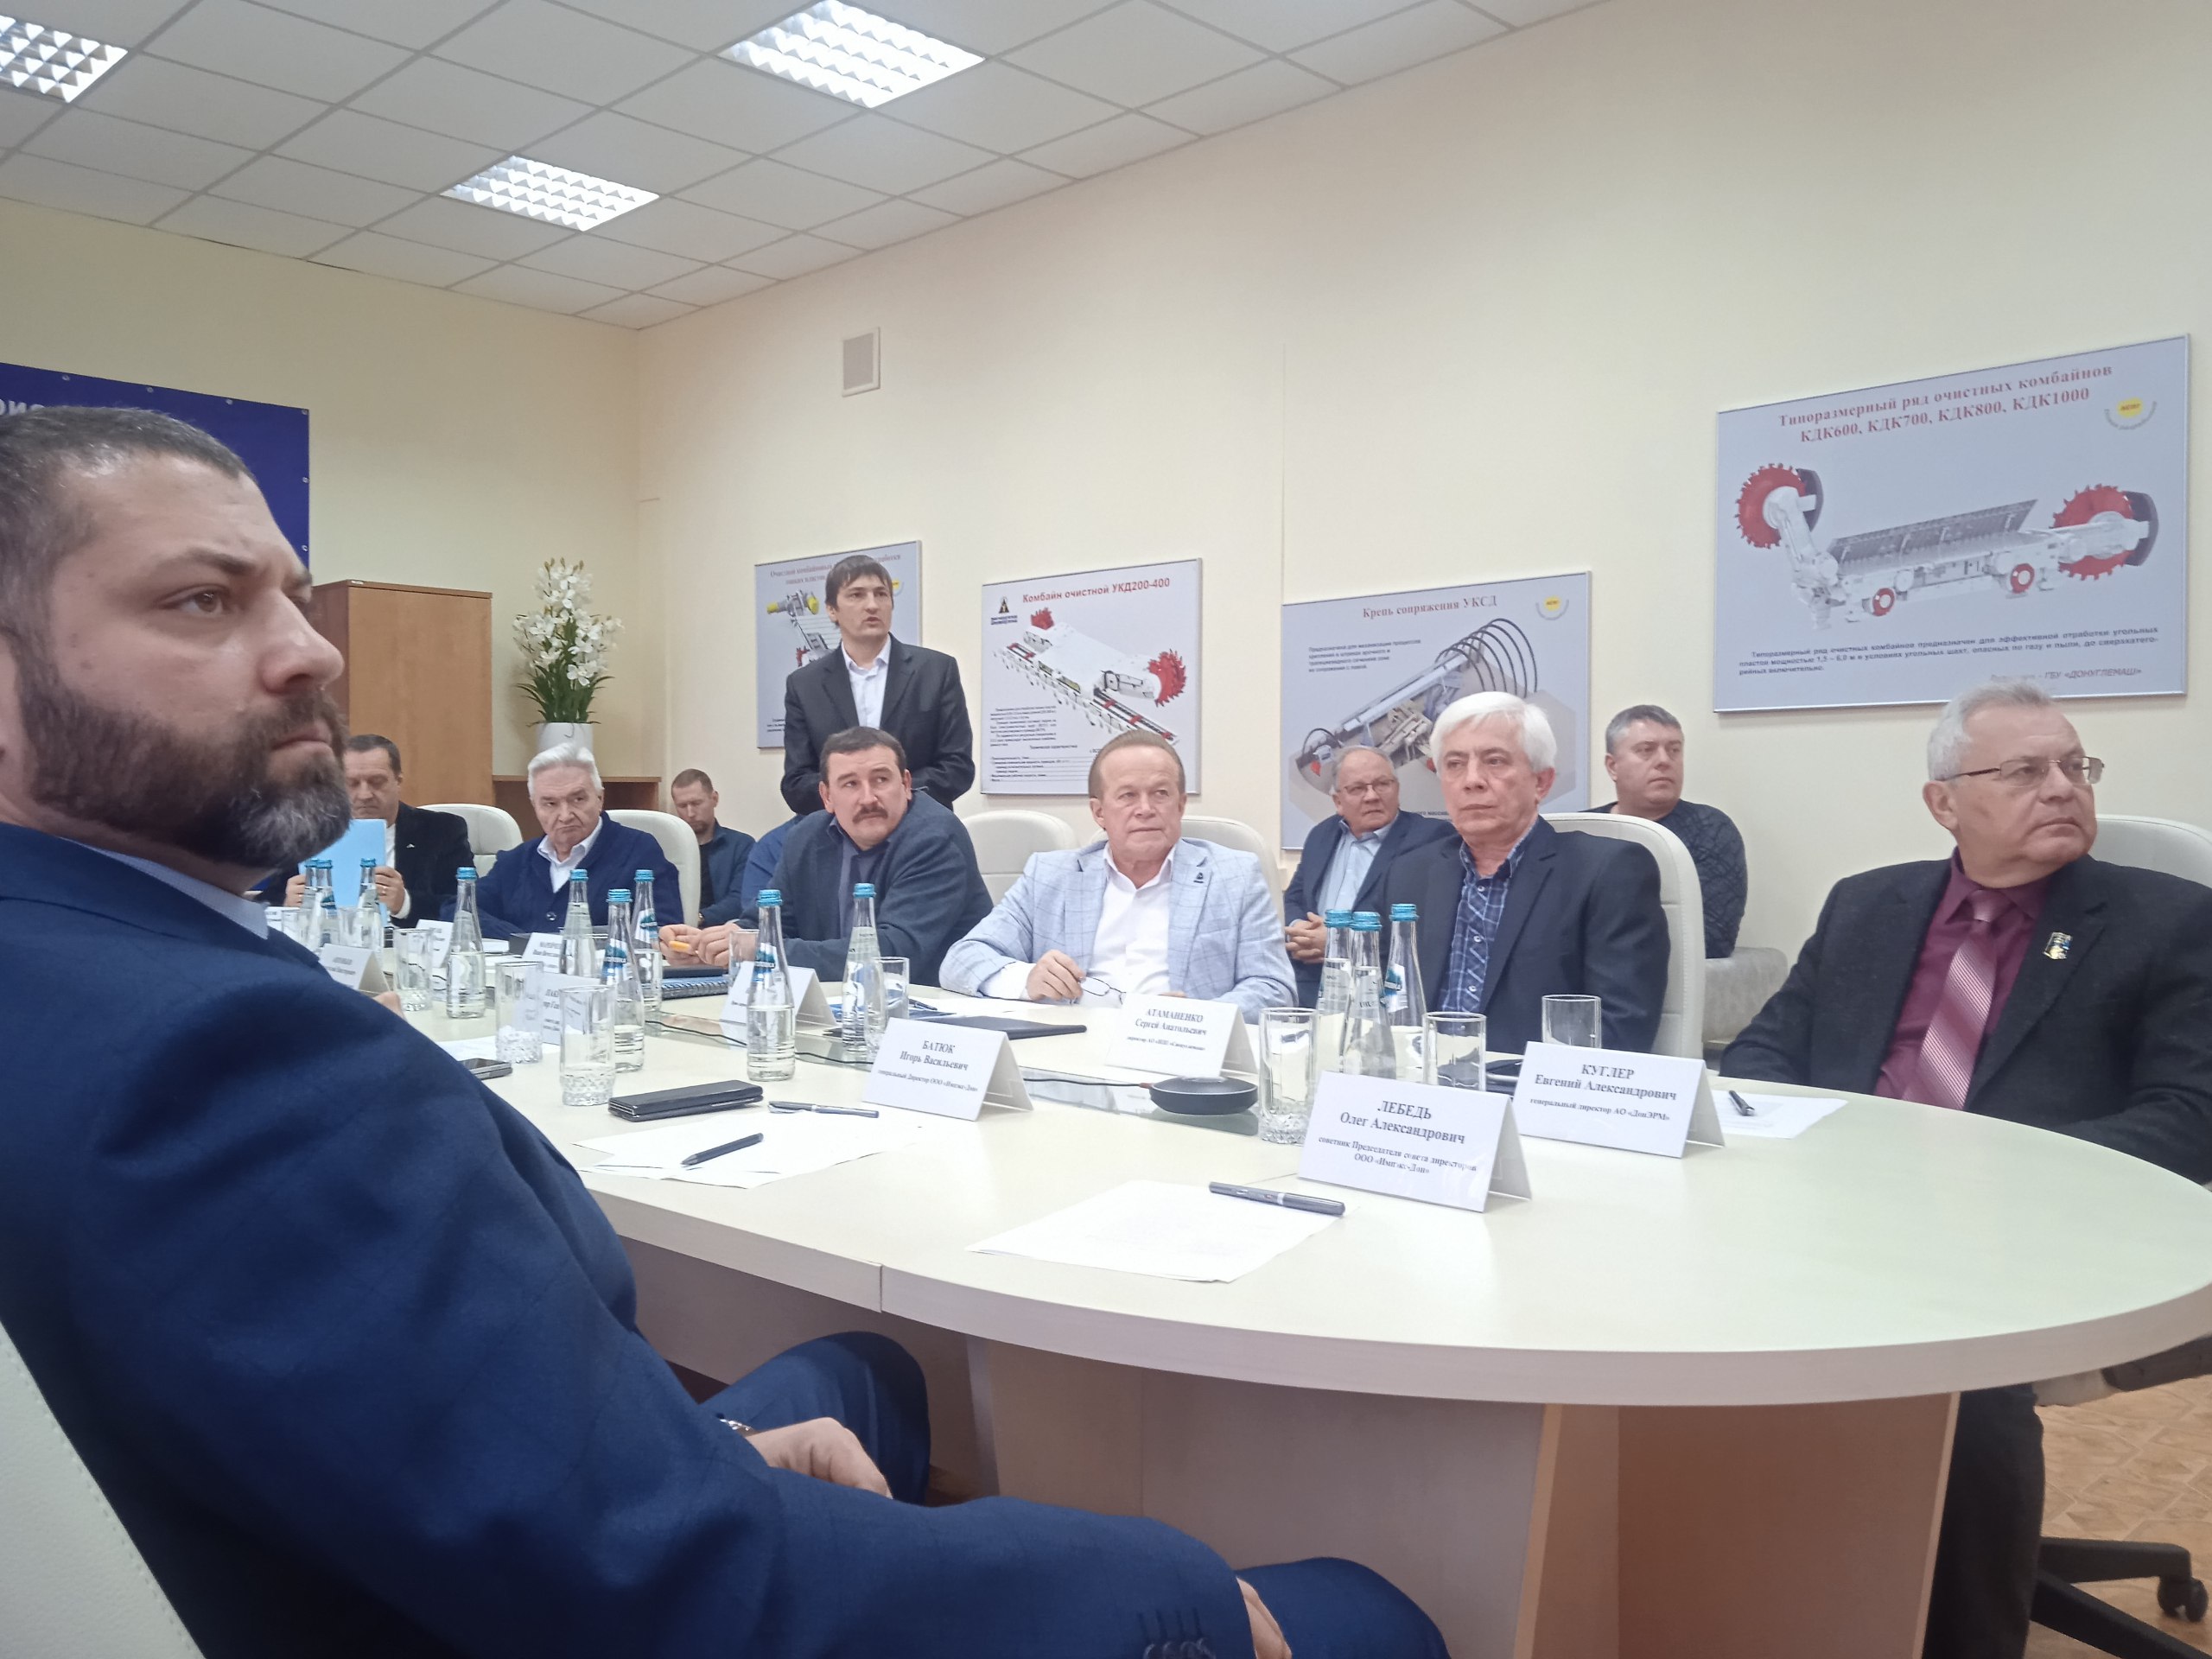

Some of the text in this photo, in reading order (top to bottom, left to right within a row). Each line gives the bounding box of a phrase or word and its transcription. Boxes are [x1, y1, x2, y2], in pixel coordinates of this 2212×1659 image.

[1778, 366, 2113, 427] Типоразмерный ряд очистных комбайнов
[2013, 388, 2089, 410] КДК1000
[1022, 577, 1170, 603] Комбайн очистной УКД200-400
[1363, 595, 1498, 620] Крепь сопряжения УКСД
[1135, 1018, 1159, 1029] Сергей
[1147, 1008, 1204, 1023] АТАМАНЕНКО
[922, 1040, 956, 1054] БАТЮК
[899, 1051, 969, 1071] Игорь Васильевич
[1581, 1064, 1635, 1080] КУГЛЕР
[1535, 1074, 1676, 1101] Евгений Александрович
[1377, 1100, 1433, 1120] ЛЕБЕДЬ
[1529, 1098, 1576, 1109] генеральный
[1579, 1104, 1611, 1115] директор
[1340, 1112, 1466, 1145] Олег Александрович
[1318, 1136, 1351, 1147] советник
[1352, 1141, 1402, 1157] Председателя
[1354, 1153, 1374, 1163] ООО
